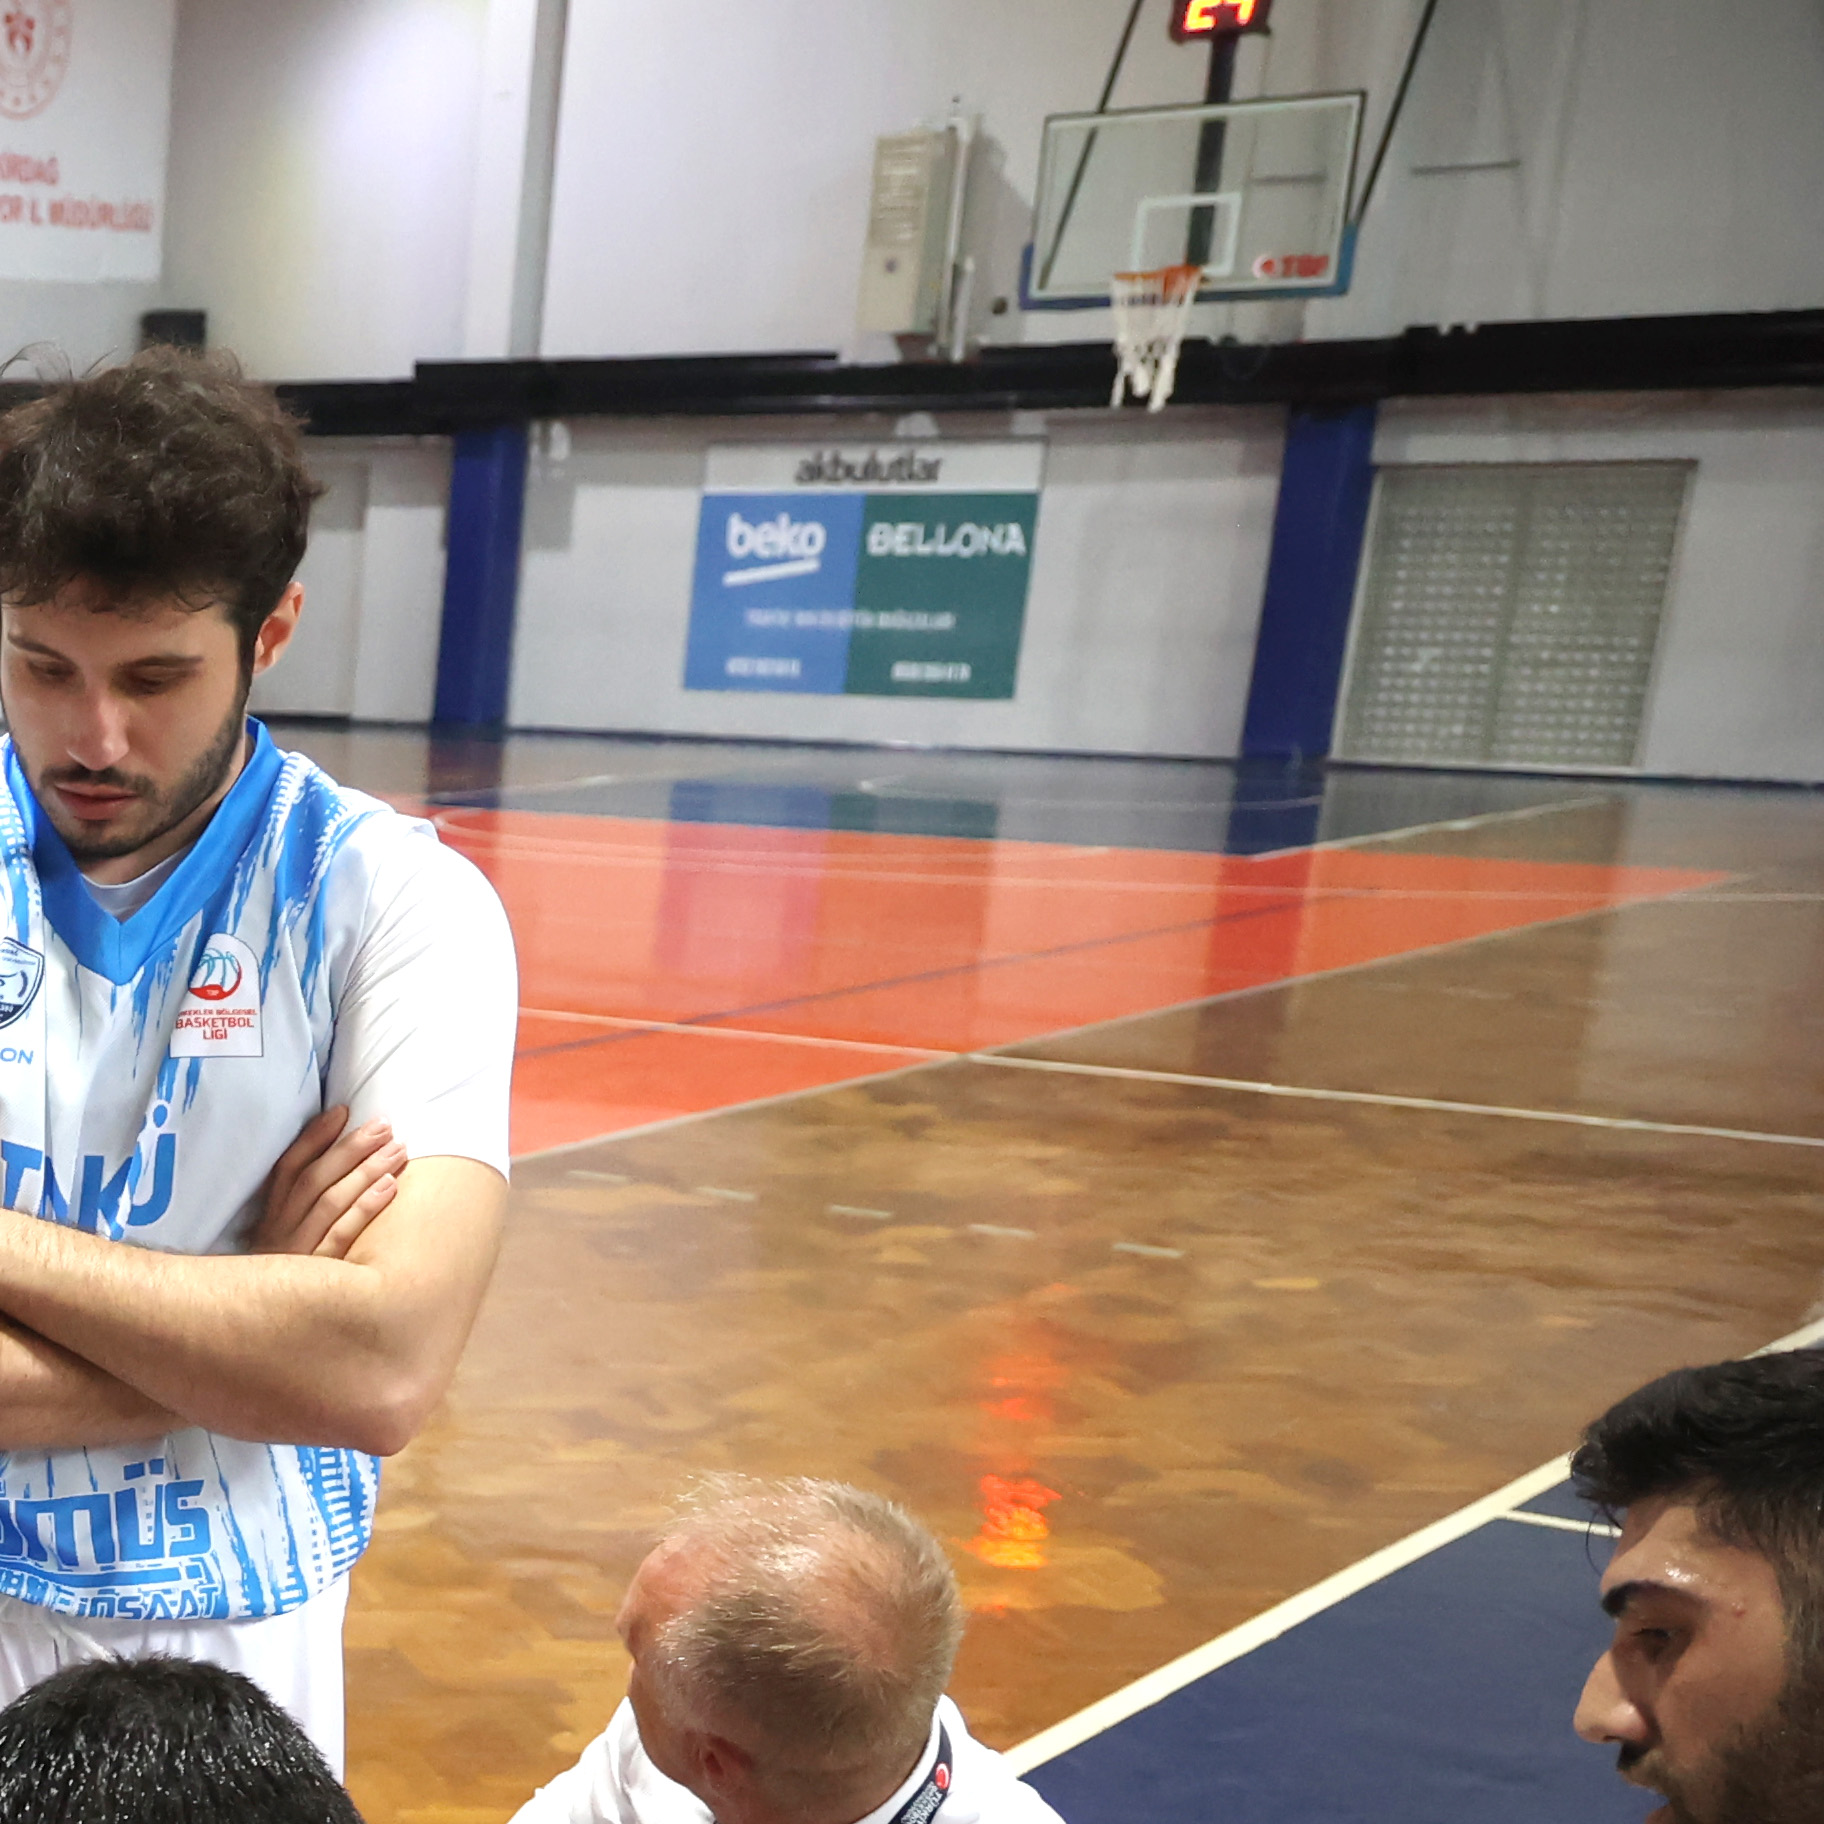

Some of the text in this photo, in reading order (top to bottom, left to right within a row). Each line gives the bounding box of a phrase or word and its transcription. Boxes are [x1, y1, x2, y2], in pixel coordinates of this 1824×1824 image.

[726, 512, 827, 558] beko
[867, 522, 1027, 558] BELLONA
[175, 1017, 255, 1029] BASKETBOL
